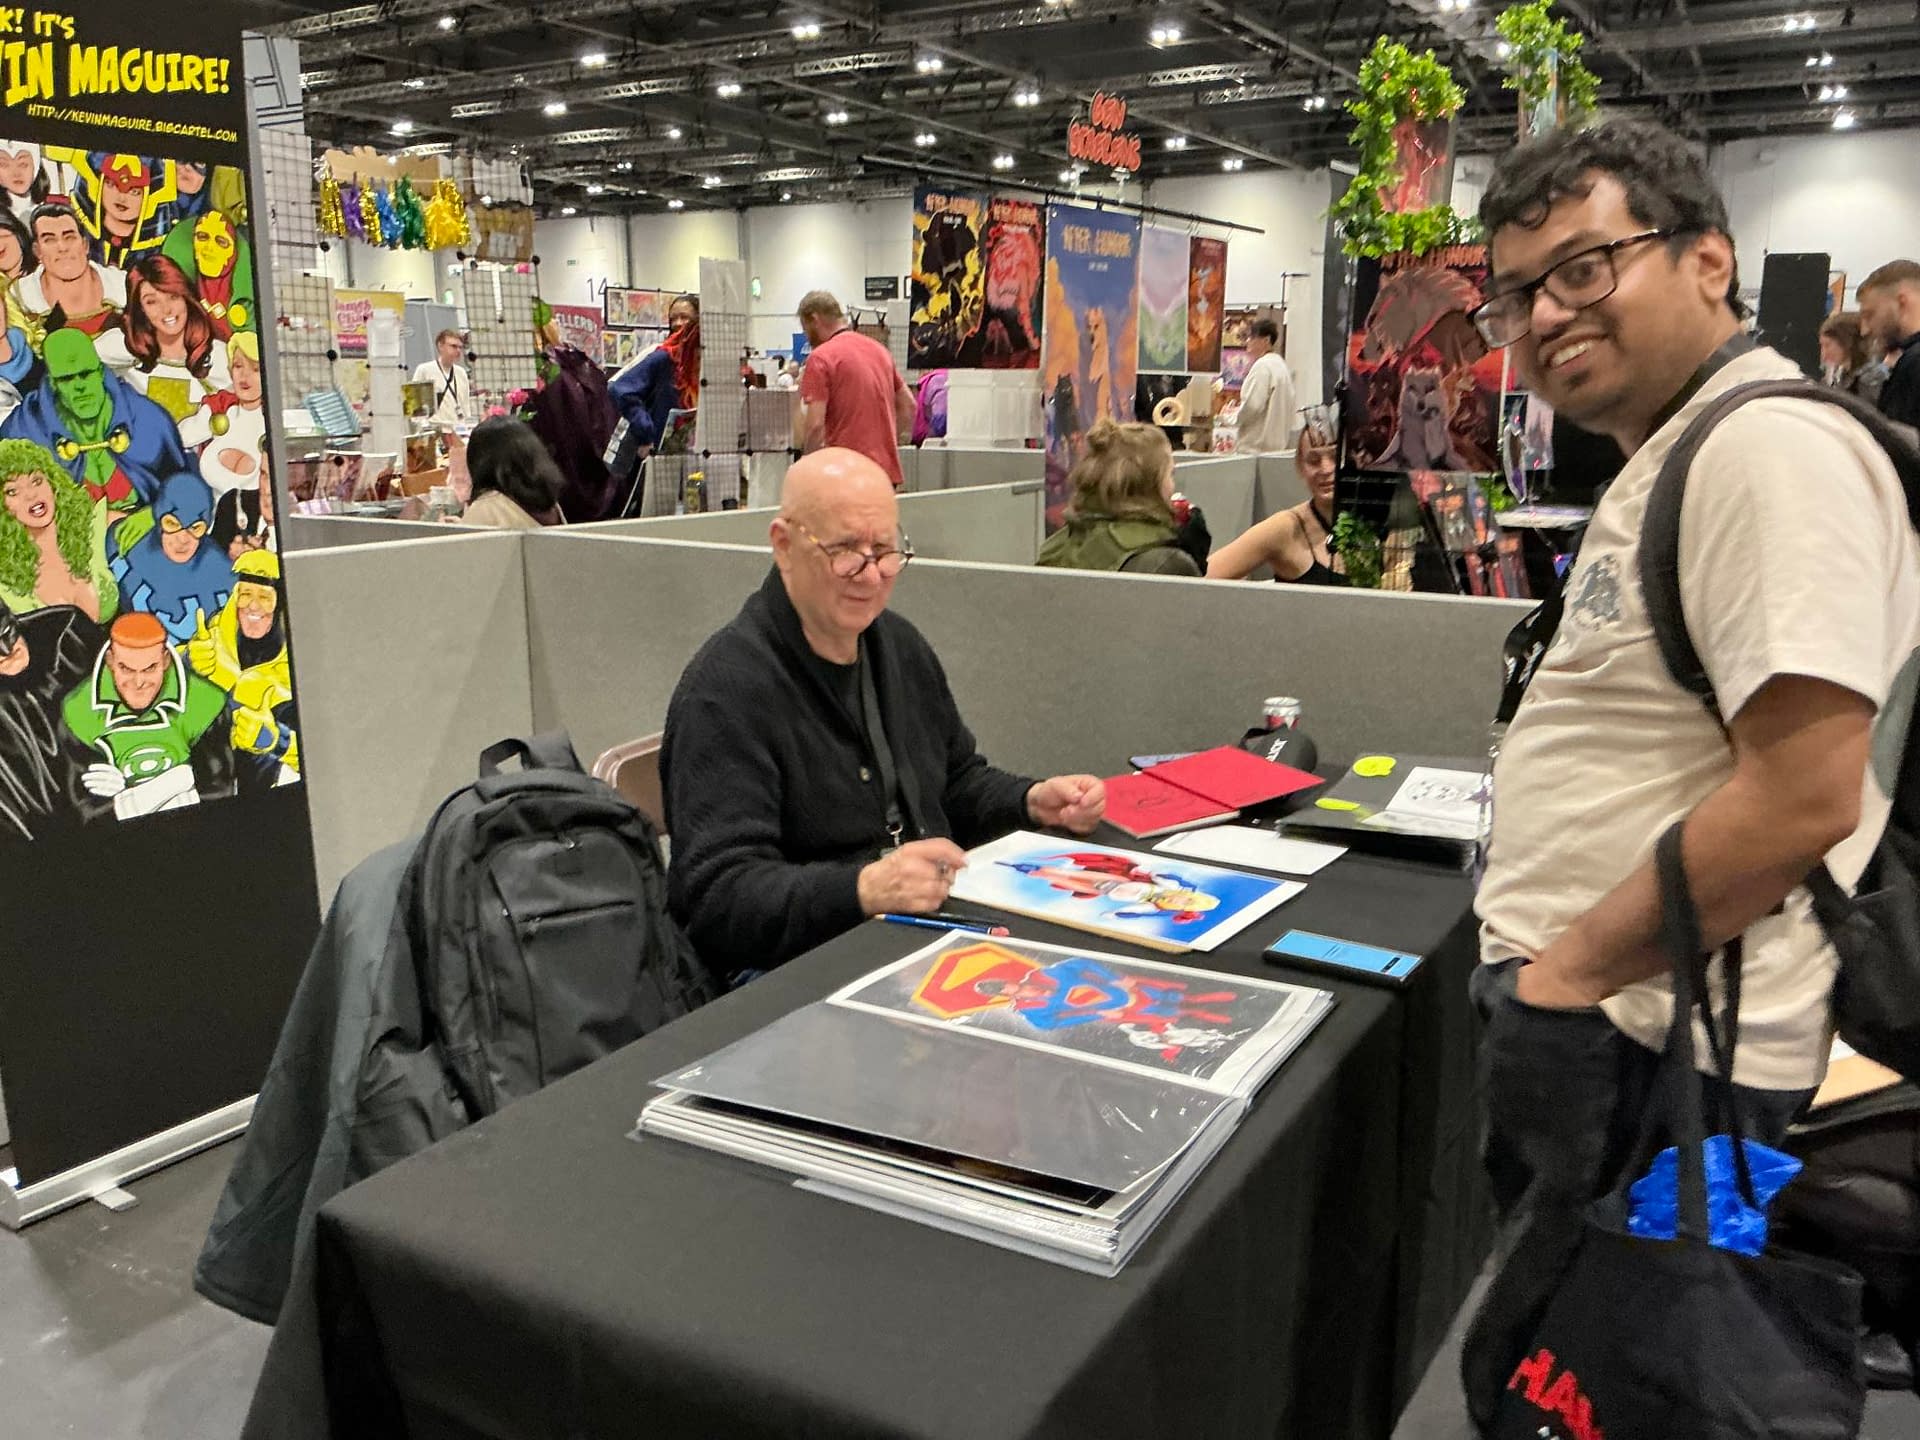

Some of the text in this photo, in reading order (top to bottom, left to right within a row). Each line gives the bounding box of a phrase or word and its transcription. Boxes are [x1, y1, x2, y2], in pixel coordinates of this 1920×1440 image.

[33, 11, 75, 39] IT'S
[69, 43, 230, 97] MAGUIRE!
[27, 103, 238, 143] HTTP://KEVINMAGUIRE.BIGCARTEL.COM
